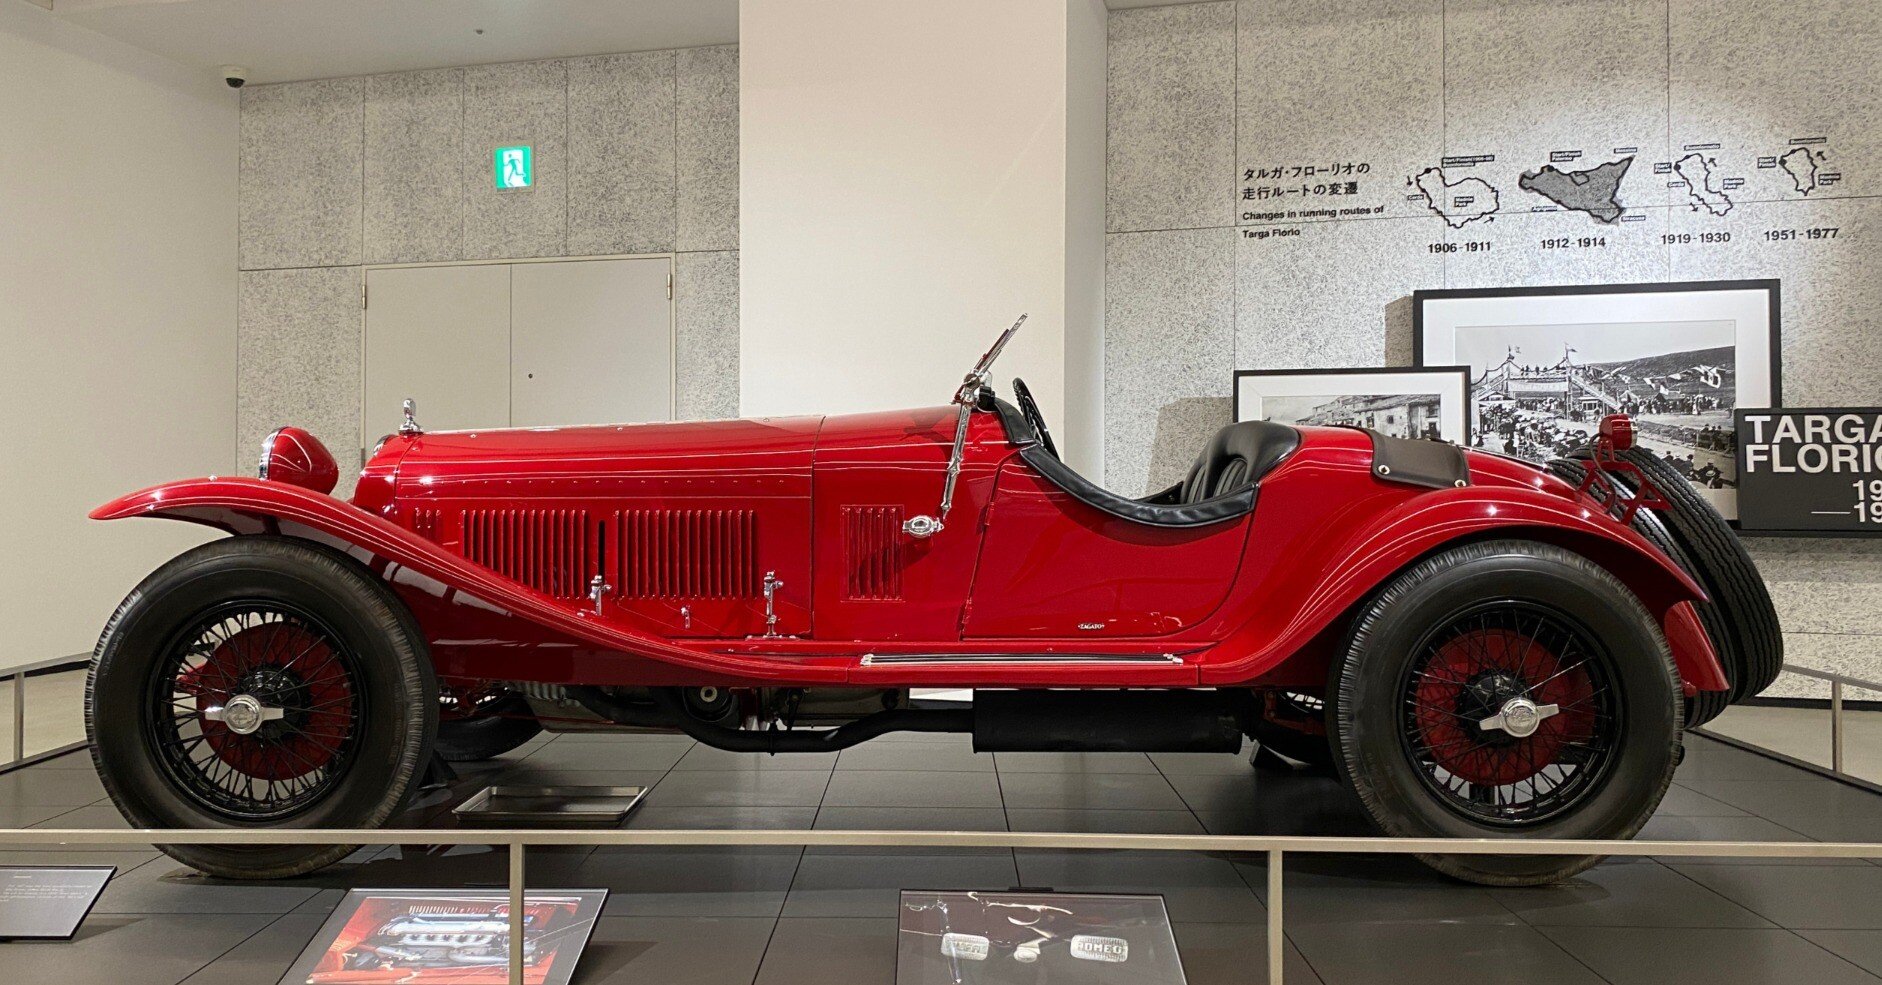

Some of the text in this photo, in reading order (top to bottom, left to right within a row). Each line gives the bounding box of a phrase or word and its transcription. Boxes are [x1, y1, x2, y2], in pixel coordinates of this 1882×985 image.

[1244, 162, 1370, 180] タルガ・フローリオの
[1242, 181, 1359, 200] 走行ルートの変遷
[1242, 205, 1384, 220] Changes in running routes of
[1242, 228, 1300, 239] Targa Florio
[1660, 232, 1731, 244] 1919-1930
[1764, 228, 1840, 241] 1951-1977
[1428, 241, 1491, 253] 1906-1911
[1541, 237, 1606, 249] 1912-1914
[1746, 444, 1882, 474] FLORI
[1077, 942, 1122, 954] ROMEO
